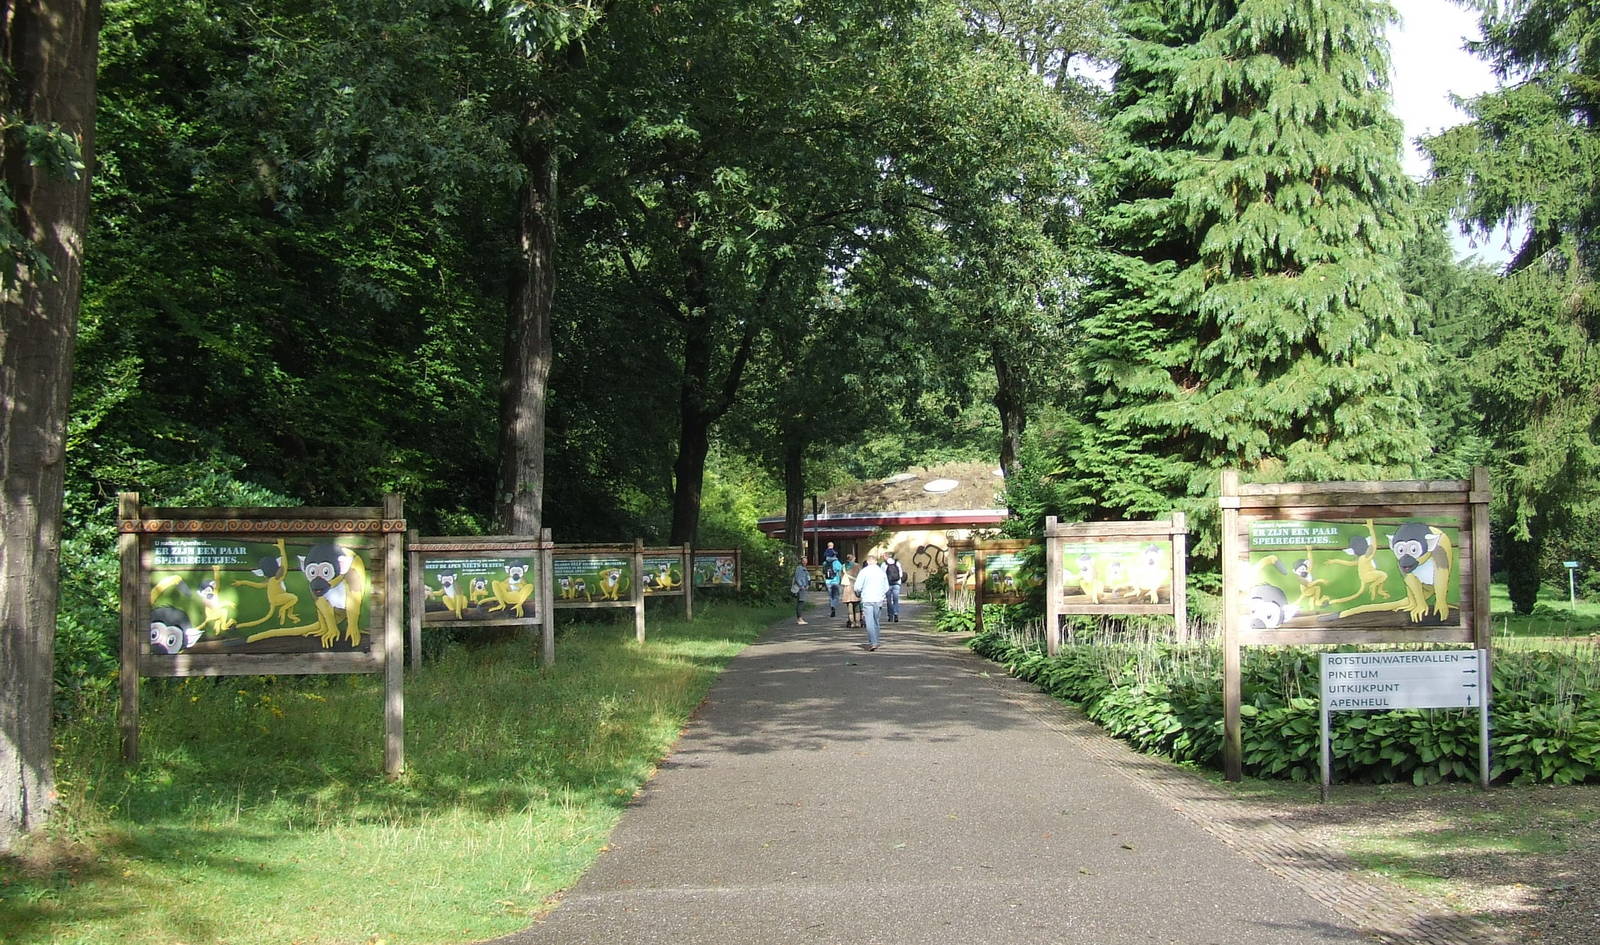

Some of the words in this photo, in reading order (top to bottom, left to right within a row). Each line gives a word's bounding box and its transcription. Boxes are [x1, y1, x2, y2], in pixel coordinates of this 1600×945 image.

[1267, 528, 1289, 536] ZIJN
[1312, 527, 1337, 535] PAAR
[155, 547, 169, 555] ER
[171, 547, 195, 555] ZIJN
[197, 547, 217, 555] EEN
[220, 547, 247, 555] PAAR
[1328, 655, 1459, 665] ROTSTUIN/WATERVALLEN
[1328, 670, 1378, 679] PINETUM
[1329, 684, 1400, 693] UITKIJKPUNT
[1330, 698, 1389, 707] APENHEUL
